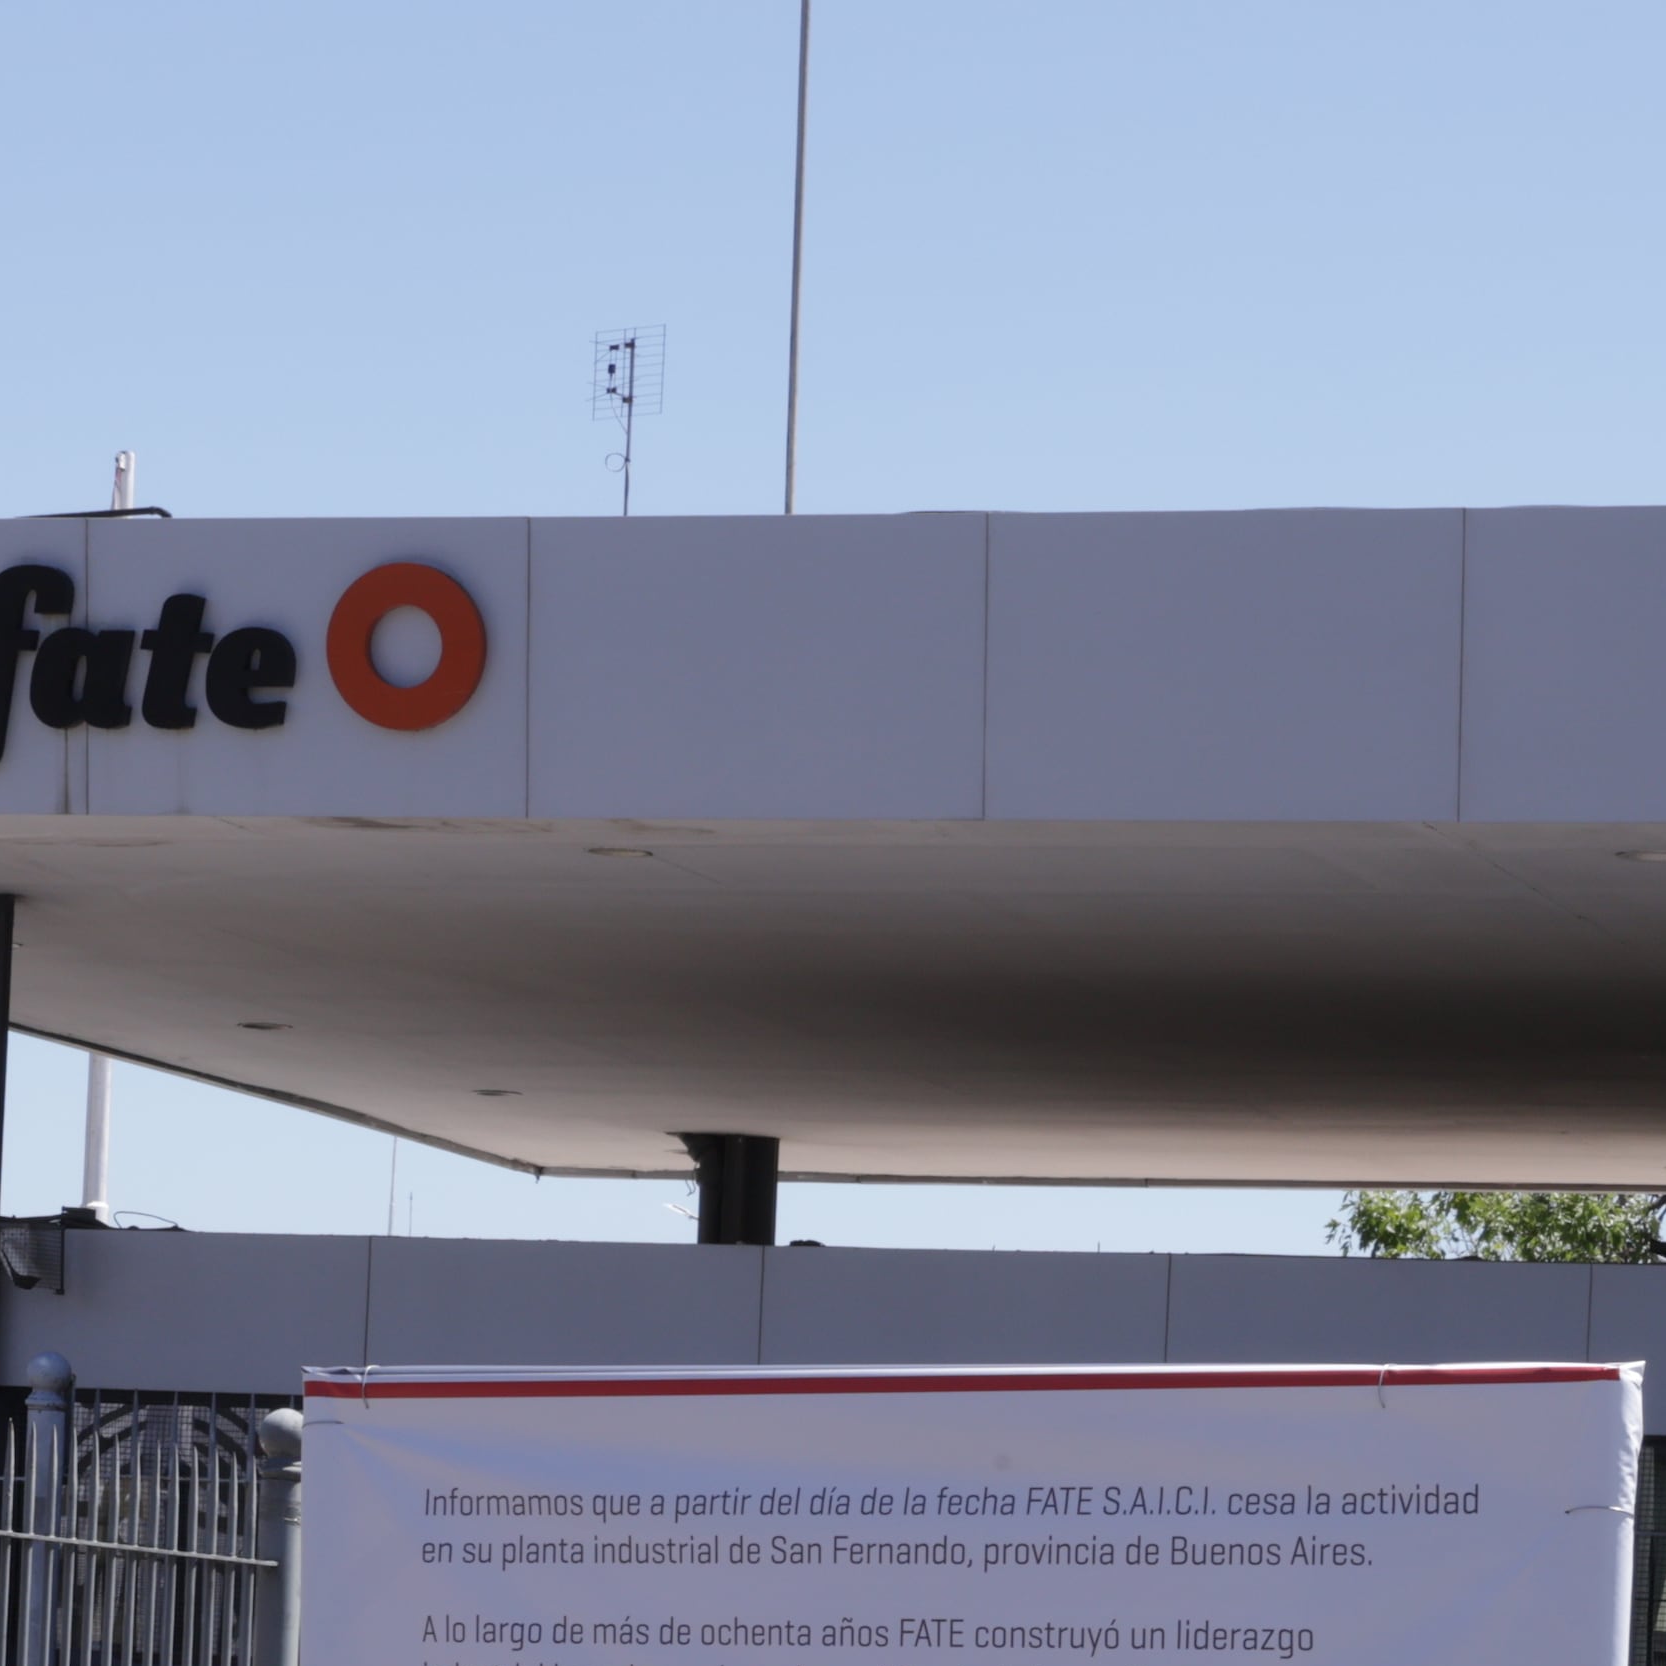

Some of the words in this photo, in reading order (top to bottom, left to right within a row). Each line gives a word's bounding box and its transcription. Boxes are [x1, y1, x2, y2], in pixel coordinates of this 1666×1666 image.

[425, 1487, 584, 1517] Informamos
[592, 1494, 641, 1524] que
[650, 1494, 665, 1516] a
[674, 1487, 752, 1524] partir
[759, 1487, 801, 1516] del
[809, 1487, 851, 1516] día
[860, 1487, 894, 1516] de
[903, 1487, 927, 1516] la
[937, 1486, 1016, 1516] fecha
[1026, 1486, 1094, 1516] FATE
[1102, 1485, 1216, 1516] S.A.I.C.I.
[1227, 1492, 1296, 1516] cesa
[1306, 1484, 1331, 1515] la
[1341, 1483, 1479, 1515] actividad
[422, 1542, 453, 1564] en
[462, 1542, 492, 1564] su
[502, 1535, 584, 1571] planta
[594, 1535, 719, 1564] industrial
[729, 1535, 761, 1565] de
[770, 1535, 822, 1565] San
[833, 1535, 973, 1568] Fernando,
[984, 1535, 1115, 1573] provincia
[1125, 1535, 1160, 1566] de
[1171, 1535, 1281, 1566] Buenos
[1290, 1535, 1372, 1566] Aires.
[422, 1615, 438, 1642] A
[446, 1614, 466, 1643] lo
[475, 1614, 542, 1652] largo
[552, 1615, 584, 1645] de
[593, 1615, 650, 1645] más
[659, 1616, 691, 1646] de
[701, 1616, 811, 1647] ochenta
[821, 1617, 889, 1648] años
[899, 1618, 964, 1648] FATE
[975, 1618, 1119, 1657] construyó
[1131, 1627, 1165, 1650] un
[1177, 1619, 1314, 1660] liderazgo
